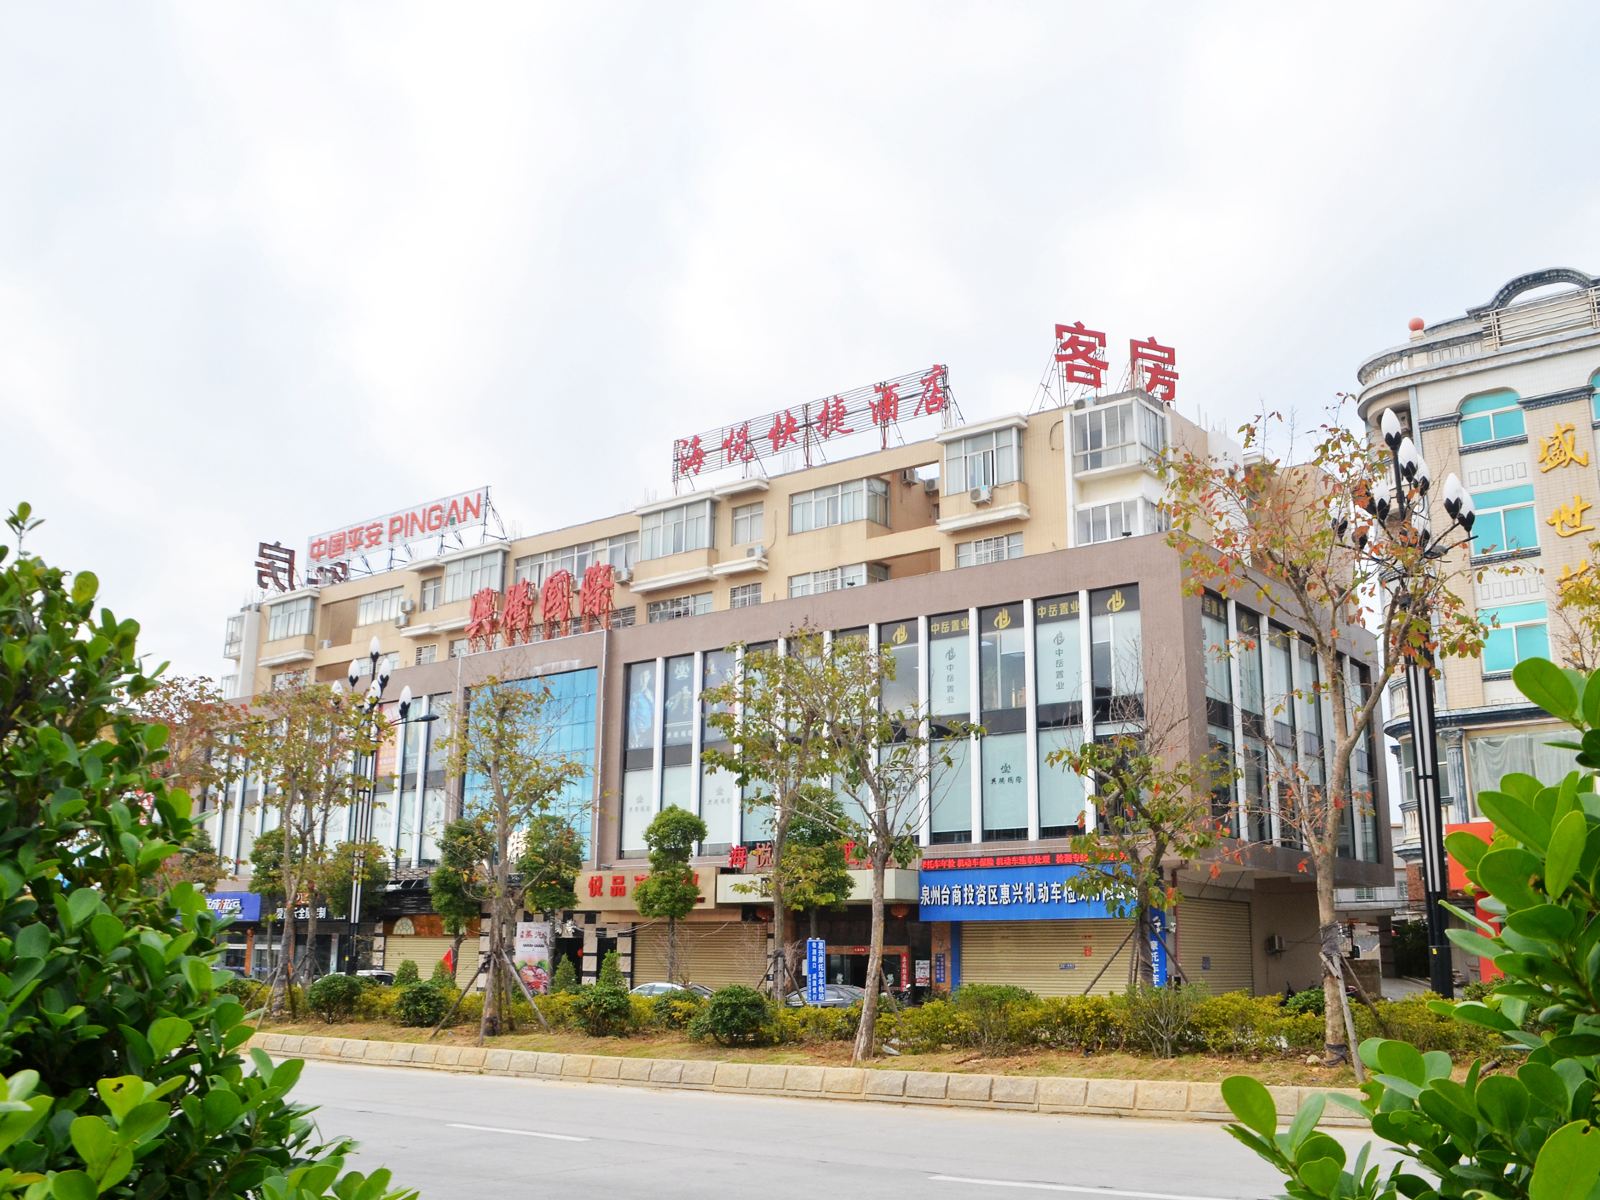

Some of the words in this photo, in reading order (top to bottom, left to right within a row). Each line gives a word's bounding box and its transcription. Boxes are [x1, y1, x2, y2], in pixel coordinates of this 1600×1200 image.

[1055, 321, 1178, 402] 客房
[677, 364, 949, 475] 海悦快捷酒店
[310, 521, 384, 562] 中国平安
[388, 493, 482, 542] PINGAN
[930, 617, 970, 634] 中岳置业
[1037, 600, 1081, 618] 中岳置业
